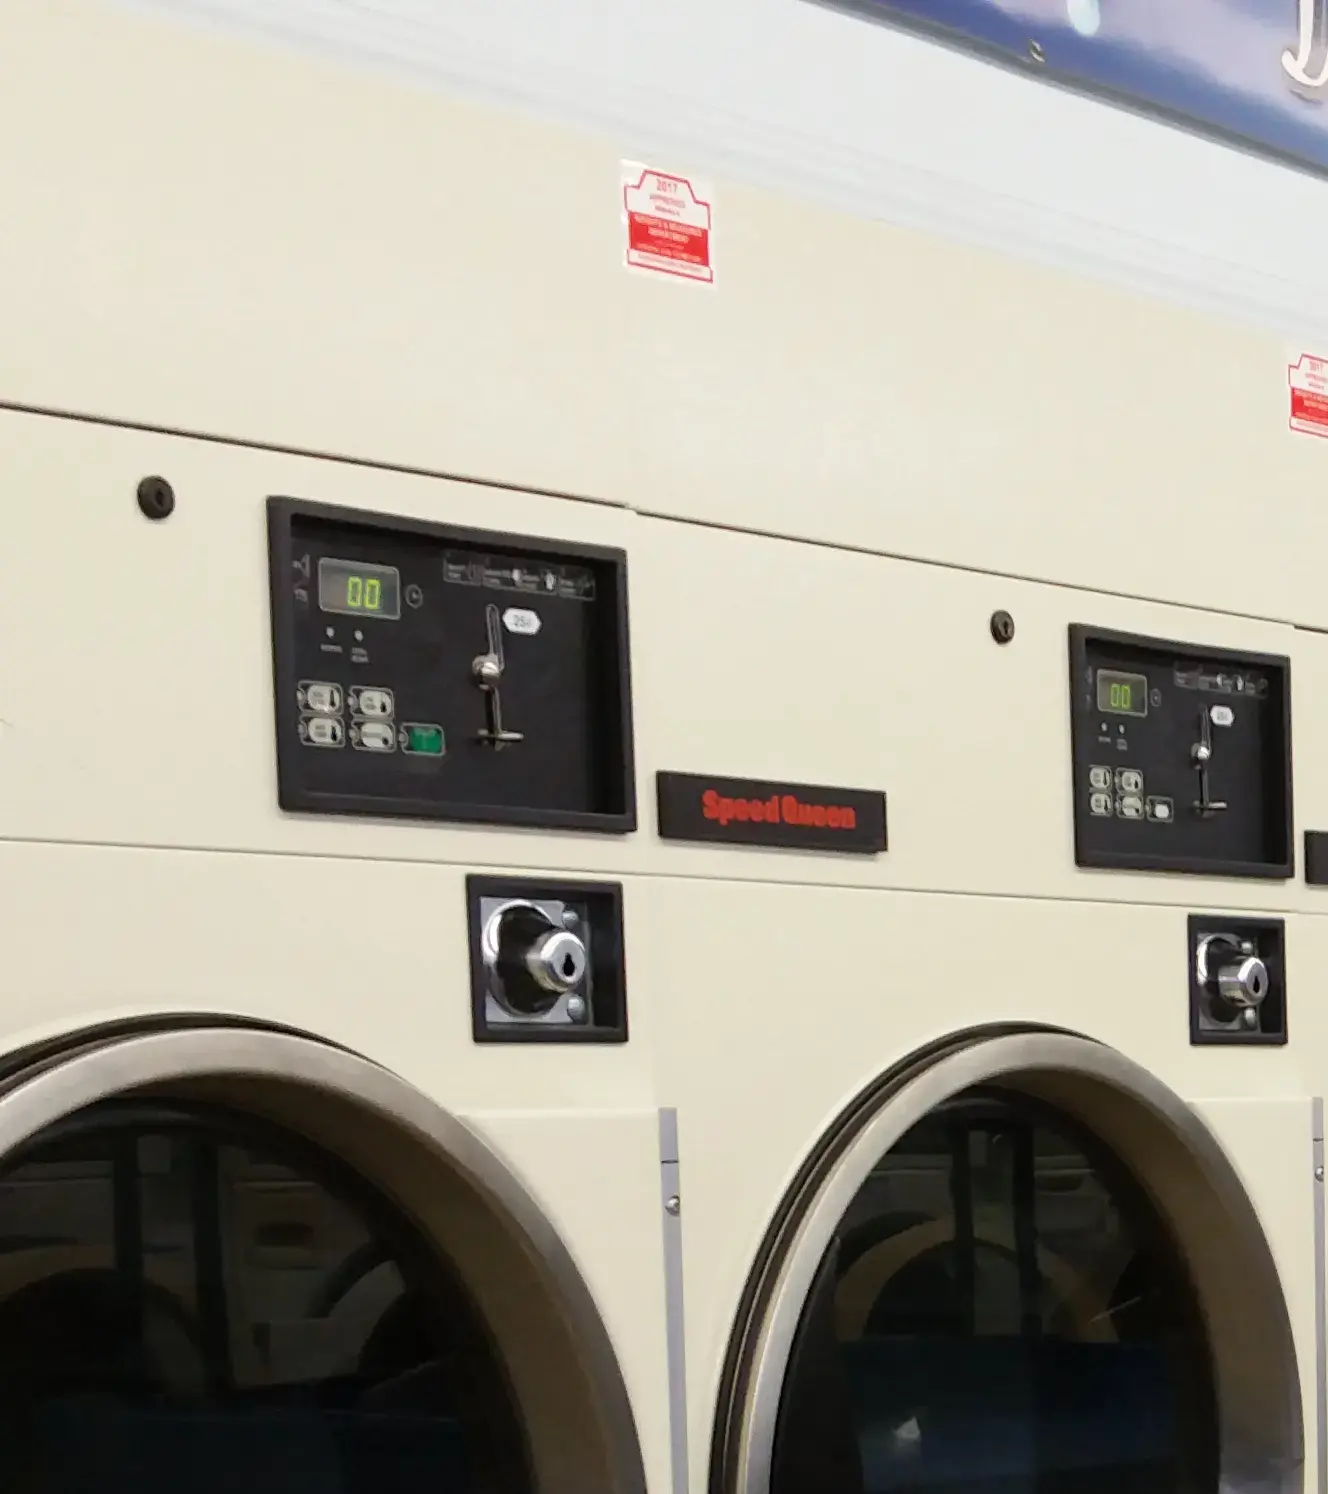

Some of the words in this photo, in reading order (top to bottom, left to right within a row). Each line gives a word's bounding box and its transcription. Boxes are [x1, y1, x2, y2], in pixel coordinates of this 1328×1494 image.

[347, 576, 381, 610] 00
[702, 789, 780, 826] Speed
[781, 795, 856, 829] Queen
